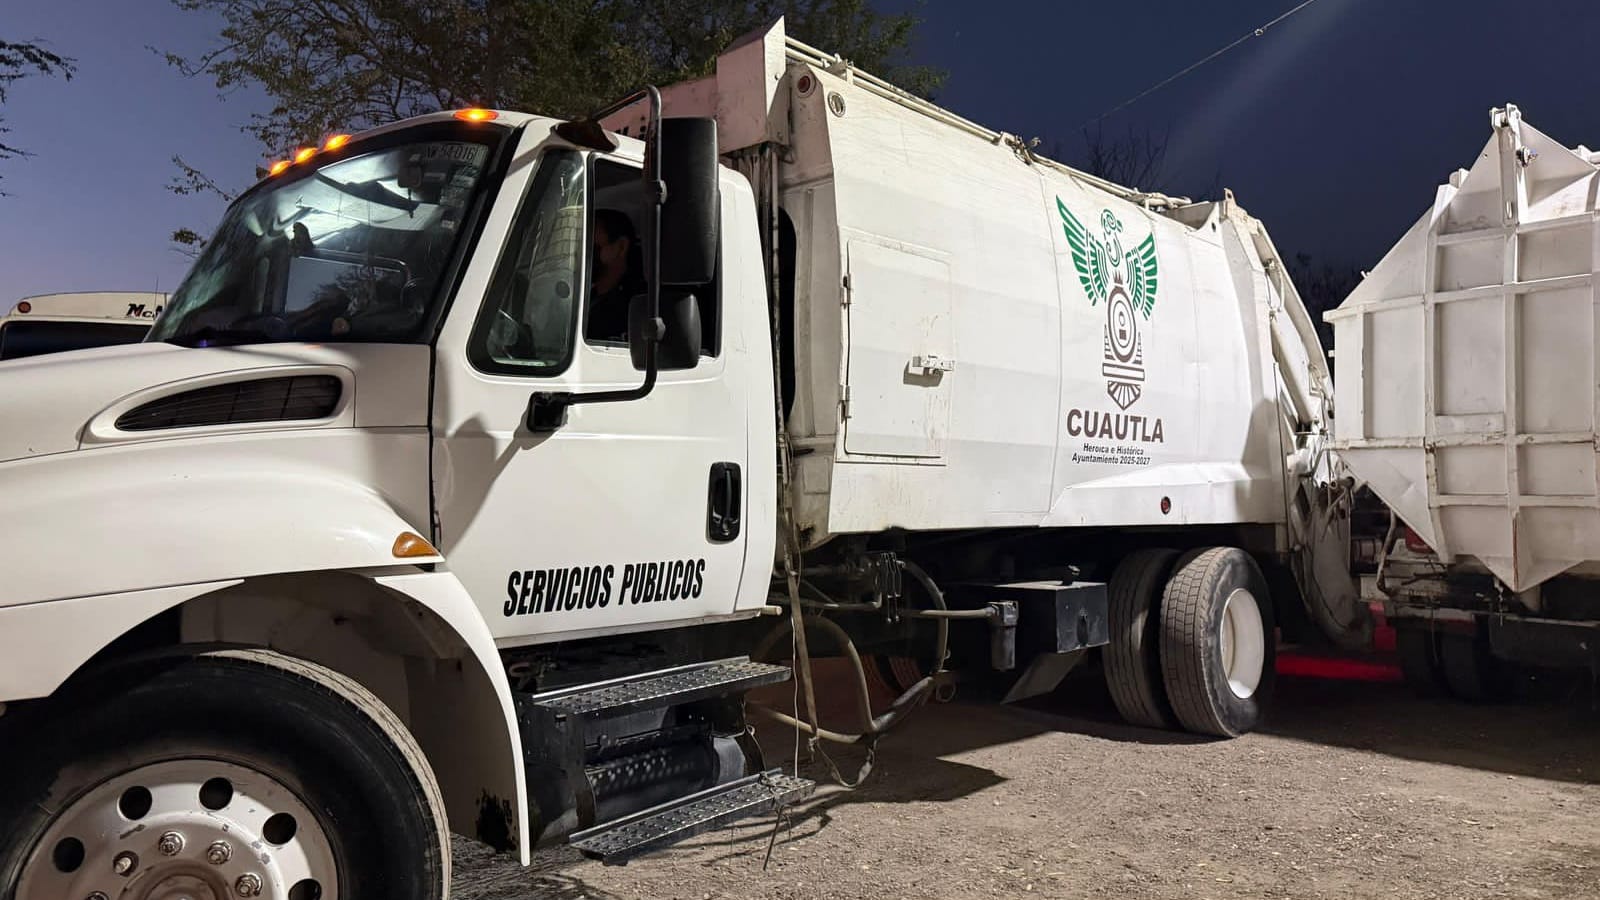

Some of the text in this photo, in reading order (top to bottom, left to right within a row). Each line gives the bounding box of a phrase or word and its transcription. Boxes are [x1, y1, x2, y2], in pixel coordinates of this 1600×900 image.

[1067, 409, 1163, 443] CUAUTLA
[1072, 453, 1151, 465] Ayuntamiento 2025-2027
[1116, 445, 1144, 456] Histórica
[504, 558, 706, 617] SERVICIOS PUBLICOS
